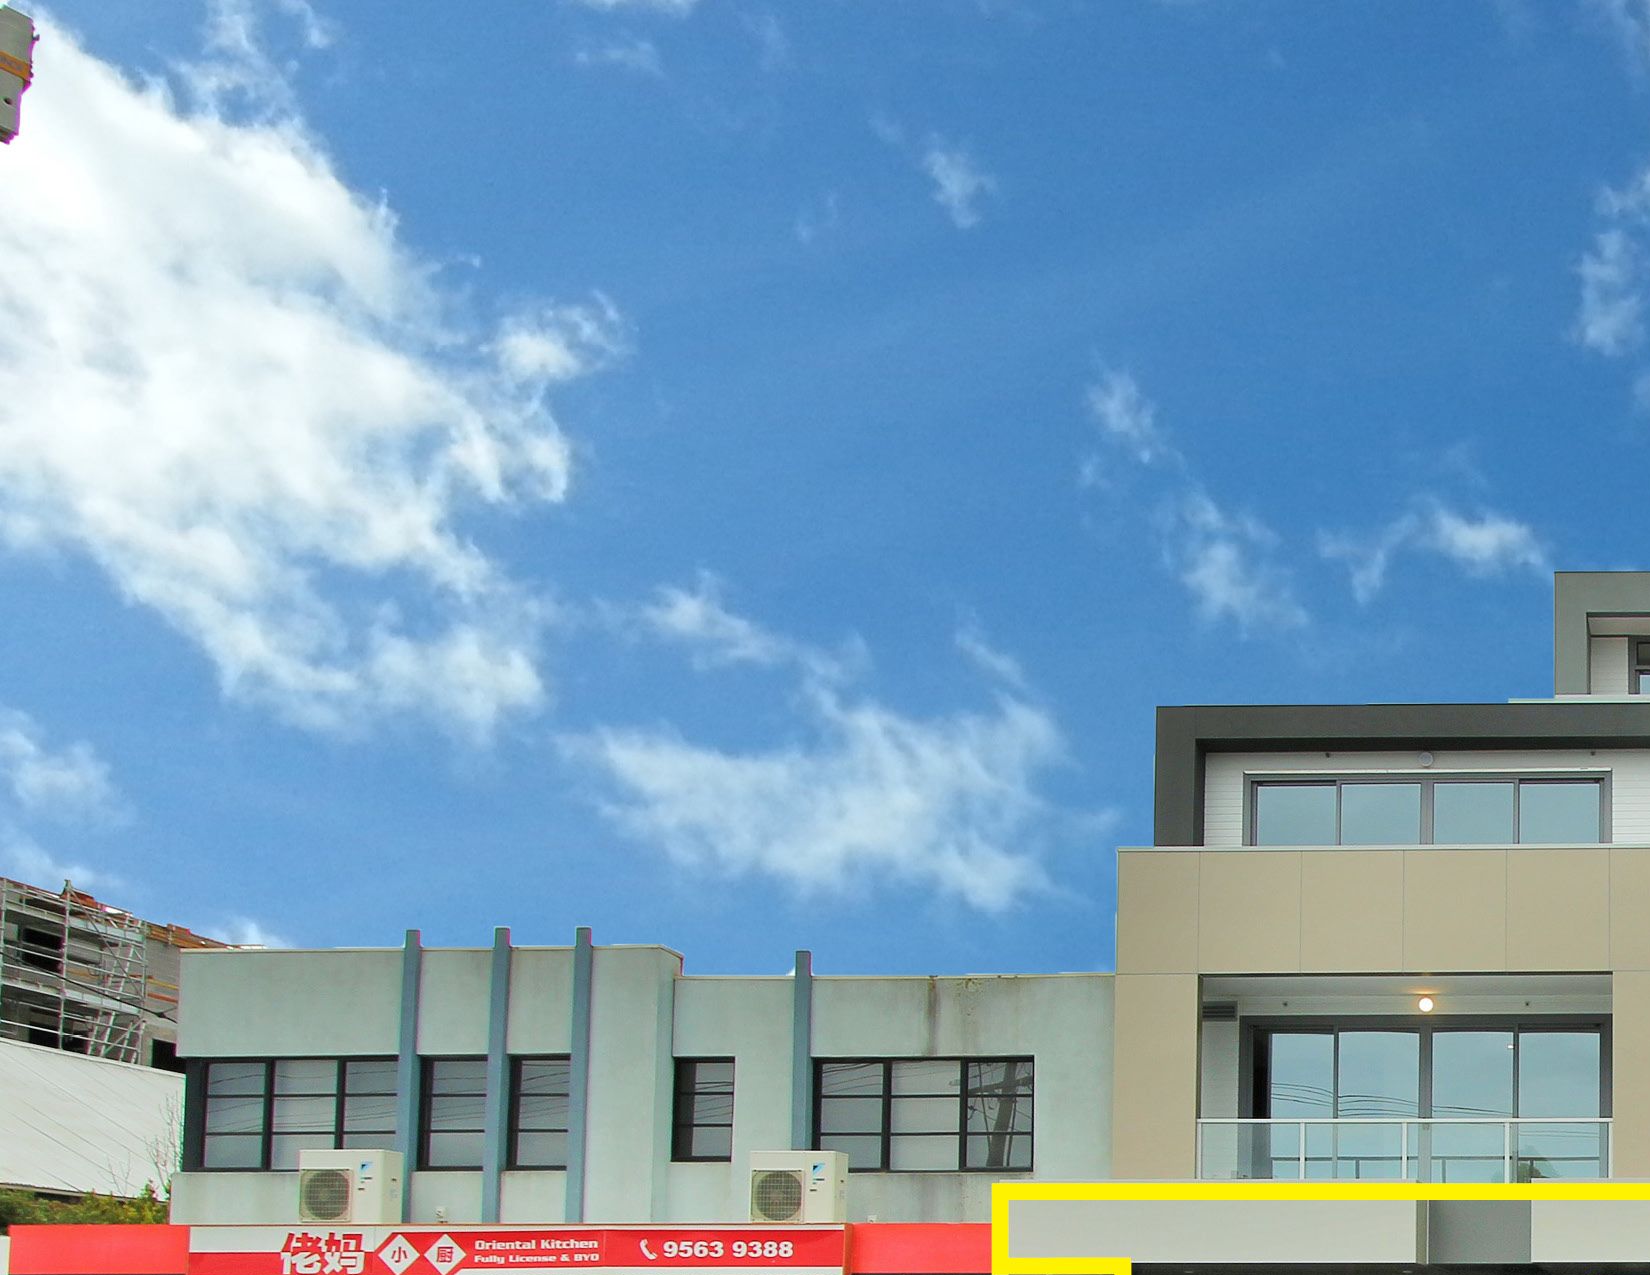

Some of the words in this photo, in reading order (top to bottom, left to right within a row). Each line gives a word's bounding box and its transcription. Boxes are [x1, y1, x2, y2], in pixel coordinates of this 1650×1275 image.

[474, 1239, 536, 1251] Oriental
[541, 1238, 599, 1250] Kitchen
[663, 1240, 725, 1258] 9563
[732, 1240, 794, 1258] 9388
[474, 1254, 505, 1264] Fully
[509, 1253, 557, 1263] License
[561, 1253, 570, 1263] &
